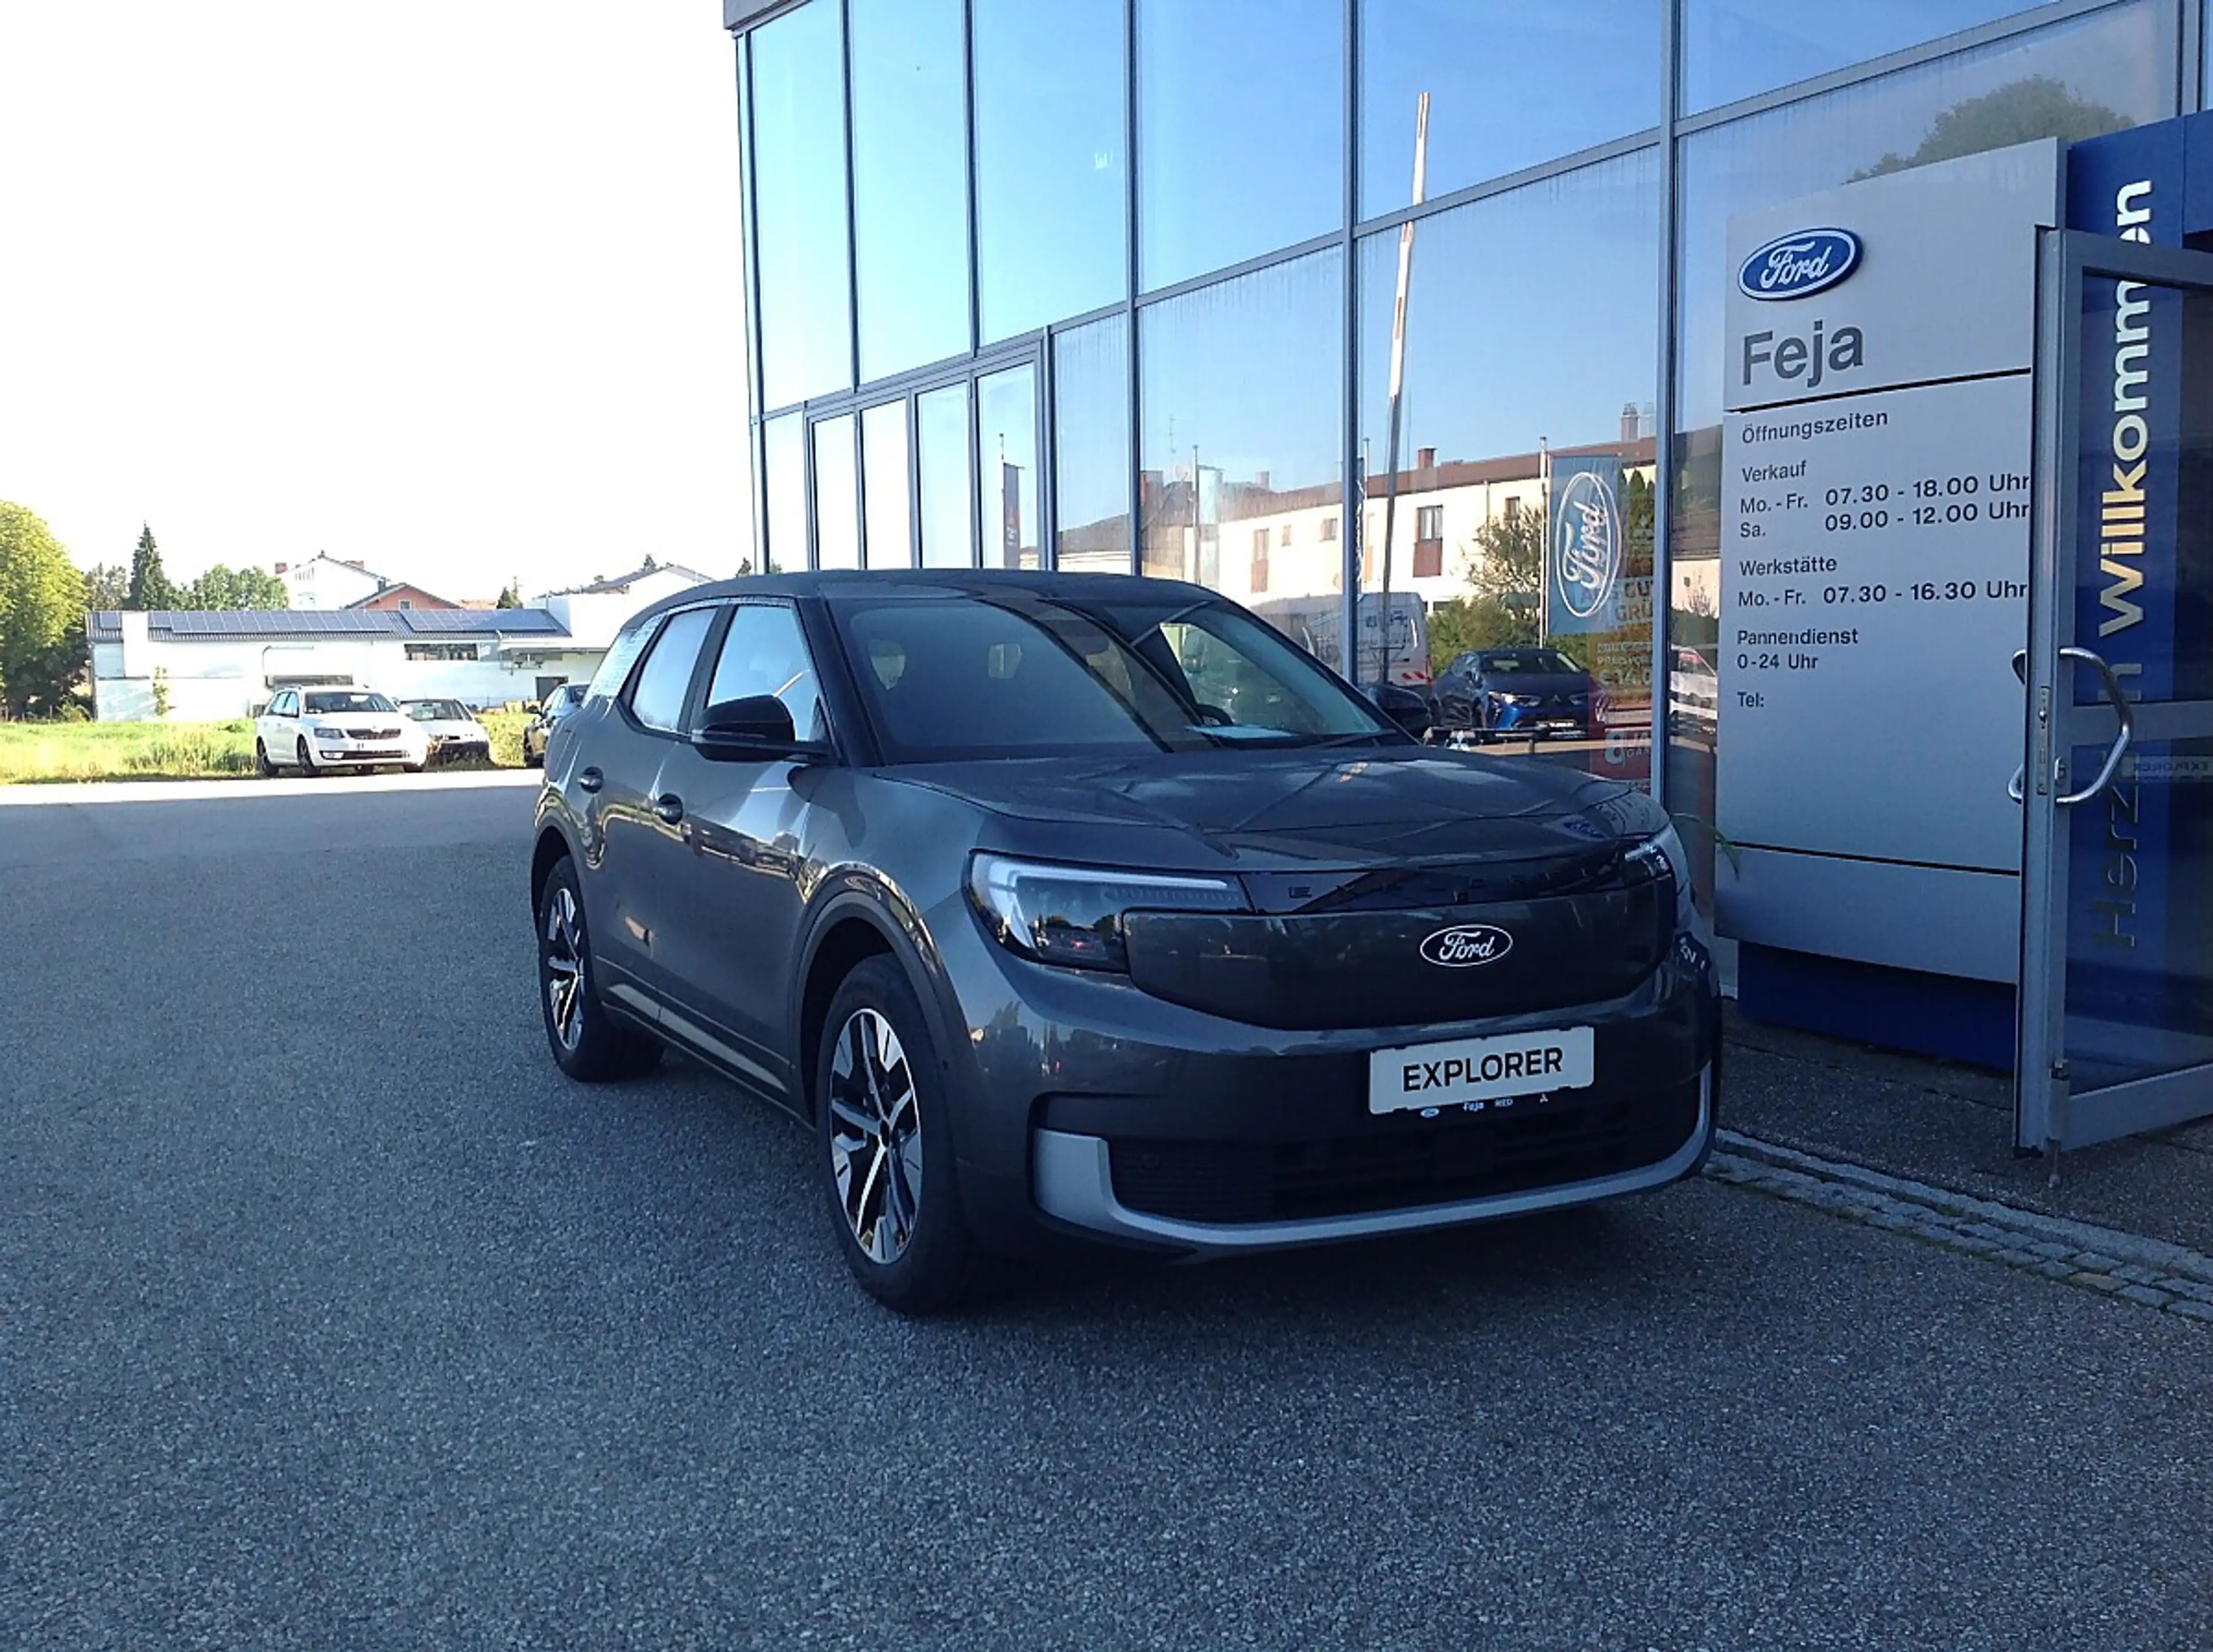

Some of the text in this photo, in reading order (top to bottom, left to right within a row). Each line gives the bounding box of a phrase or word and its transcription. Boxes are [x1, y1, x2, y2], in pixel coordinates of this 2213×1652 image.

[1760, 241, 1833, 289] Ford
[1743, 319, 1864, 388] Feja
[1742, 411, 1888, 444] Öffnungszeiten
[1741, 459, 1807, 483] Verkauf
[1825, 484, 1890, 506] 07.30
[1912, 475, 1978, 498] 18.00
[1989, 472, 2030, 492] Uhr
[1740, 521, 1766, 538] Sa.
[1825, 510, 1889, 532] 09.00
[1912, 502, 1978, 525] 12.00
[1989, 500, 2029, 519] Uhr
[1562, 500, 1608, 589] Ford
[1739, 555, 1838, 576] Werkstätte
[1823, 584, 1887, 604] 07.30
[1910, 580, 1976, 600] 16.30
[1986, 580, 2028, 599] Uhr
[1736, 628, 1859, 645] Pannendienst
[1788, 653, 1819, 670] Uhr
[1736, 691, 1765, 708] Tel:
[1438, 931, 1495, 961] Ford
[1403, 1046, 1564, 1092] EXPLORER
